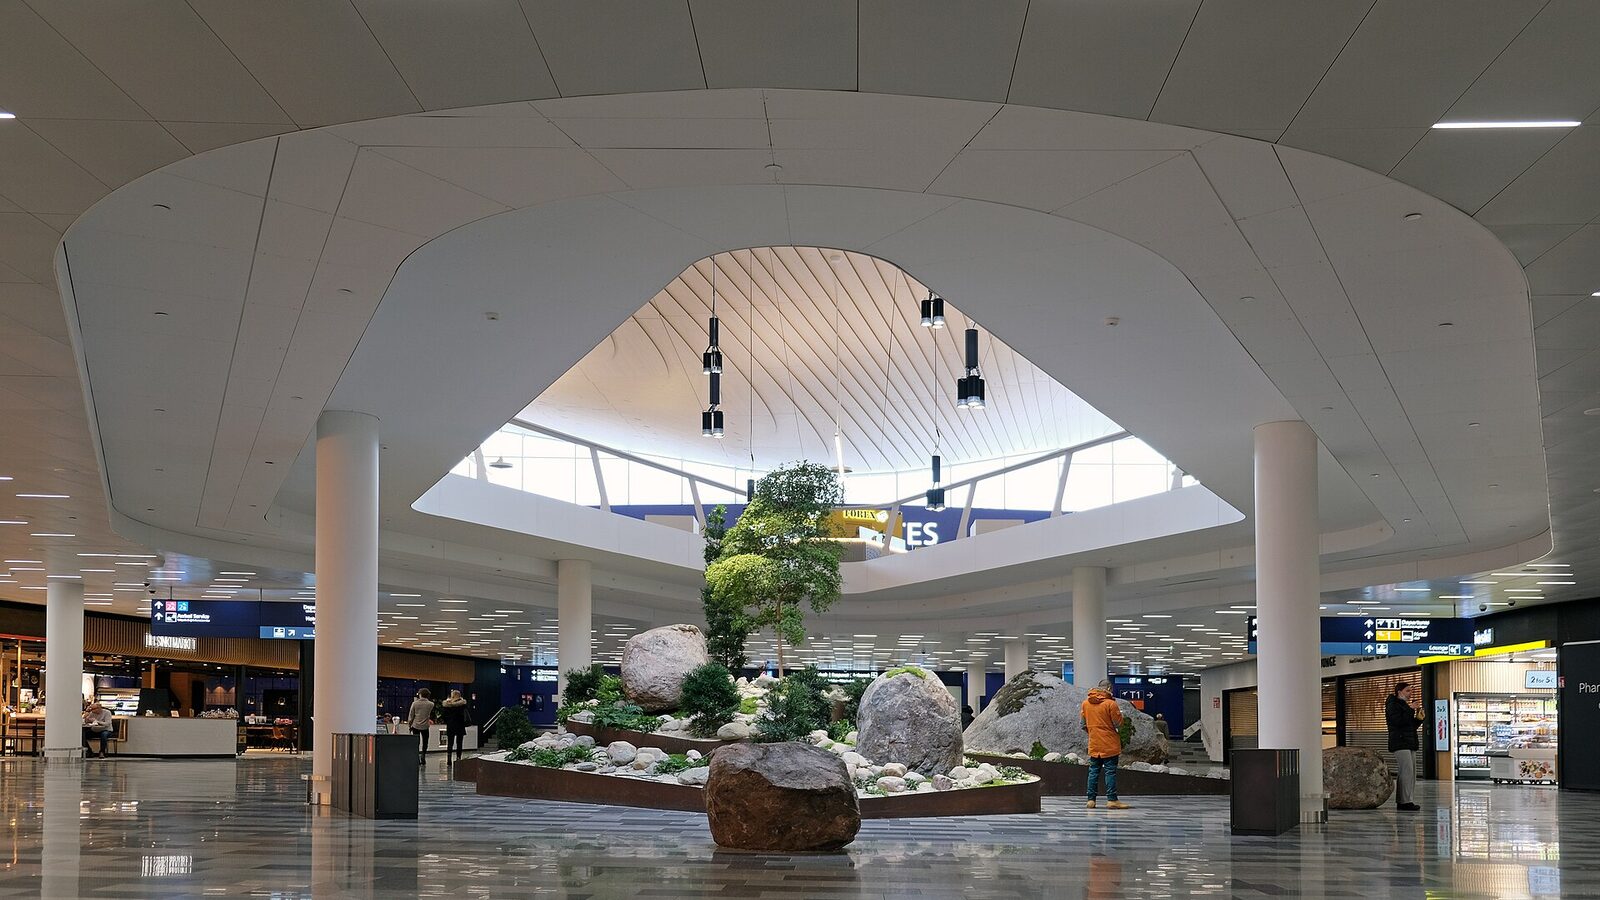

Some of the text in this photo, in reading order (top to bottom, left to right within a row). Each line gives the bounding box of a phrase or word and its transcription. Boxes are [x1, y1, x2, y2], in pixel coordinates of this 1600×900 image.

[844, 510, 875, 520] FOREX
[902, 521, 939, 546] ES
[1429, 645, 1449, 653] Lounge
[1130, 691, 1140, 699] T1
